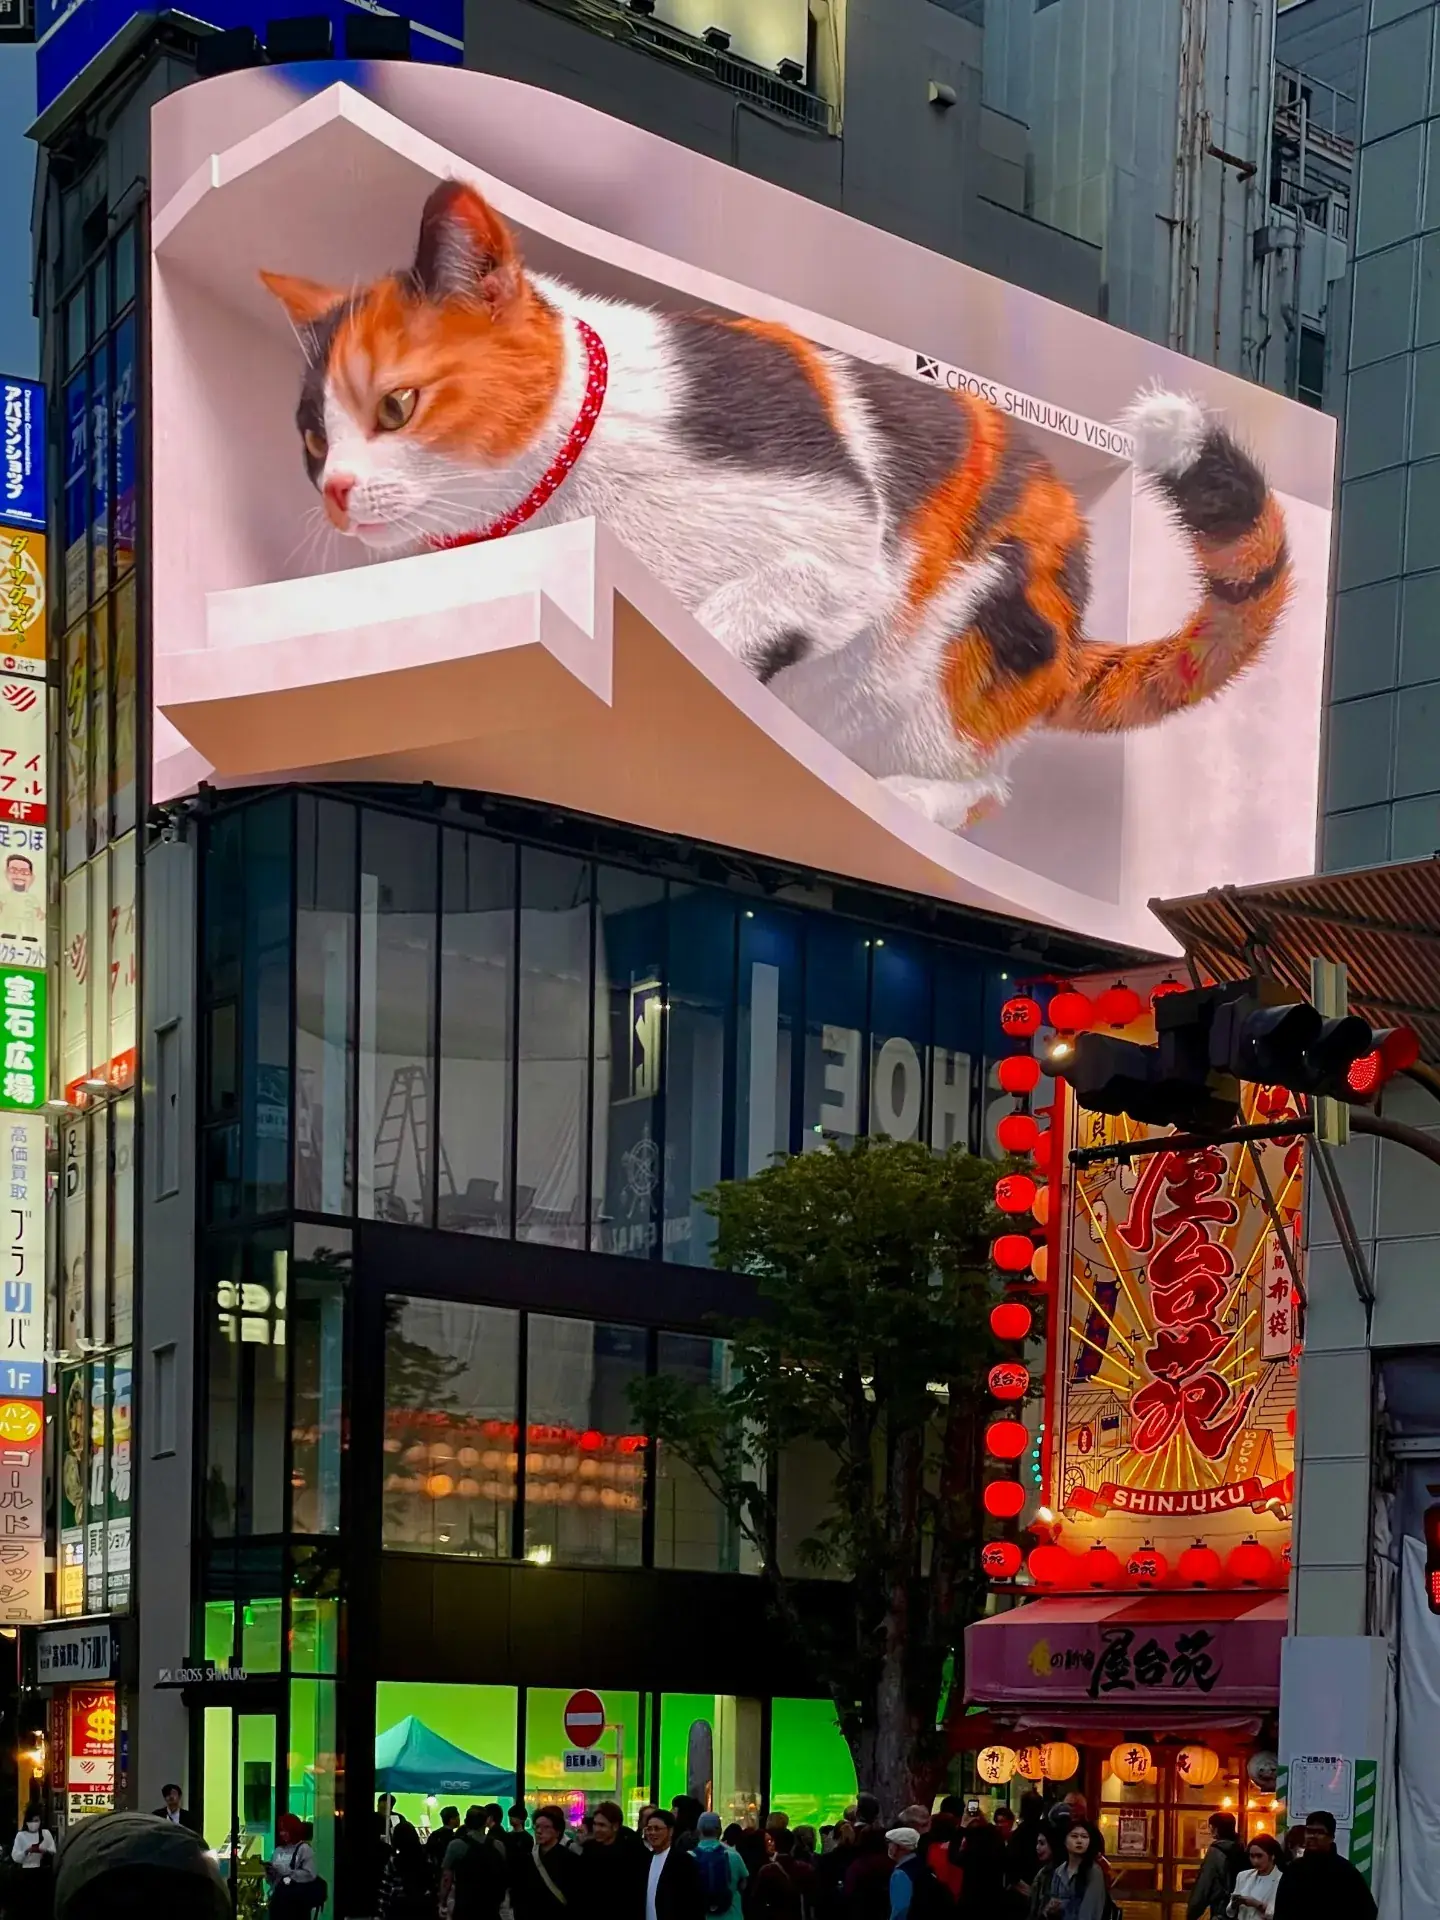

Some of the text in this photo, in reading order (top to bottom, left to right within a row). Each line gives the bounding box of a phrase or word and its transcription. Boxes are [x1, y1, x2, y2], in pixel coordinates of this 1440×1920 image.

[946, 370, 1136, 455] CROSS SHINJUKU VISION
[8, 803, 32, 820] 4F
[3, 975, 36, 1105] 宝石広場
[10, 1125, 28, 1201] 高価買取
[1265, 1275, 1291, 1336] 布袋
[7, 1368, 32, 1390] 1F
[1113, 1484, 1246, 1514] SHINJUKU
[175, 1667, 202, 1682] CROSS
[1086, 1628, 1224, 1699] 屋台苑
